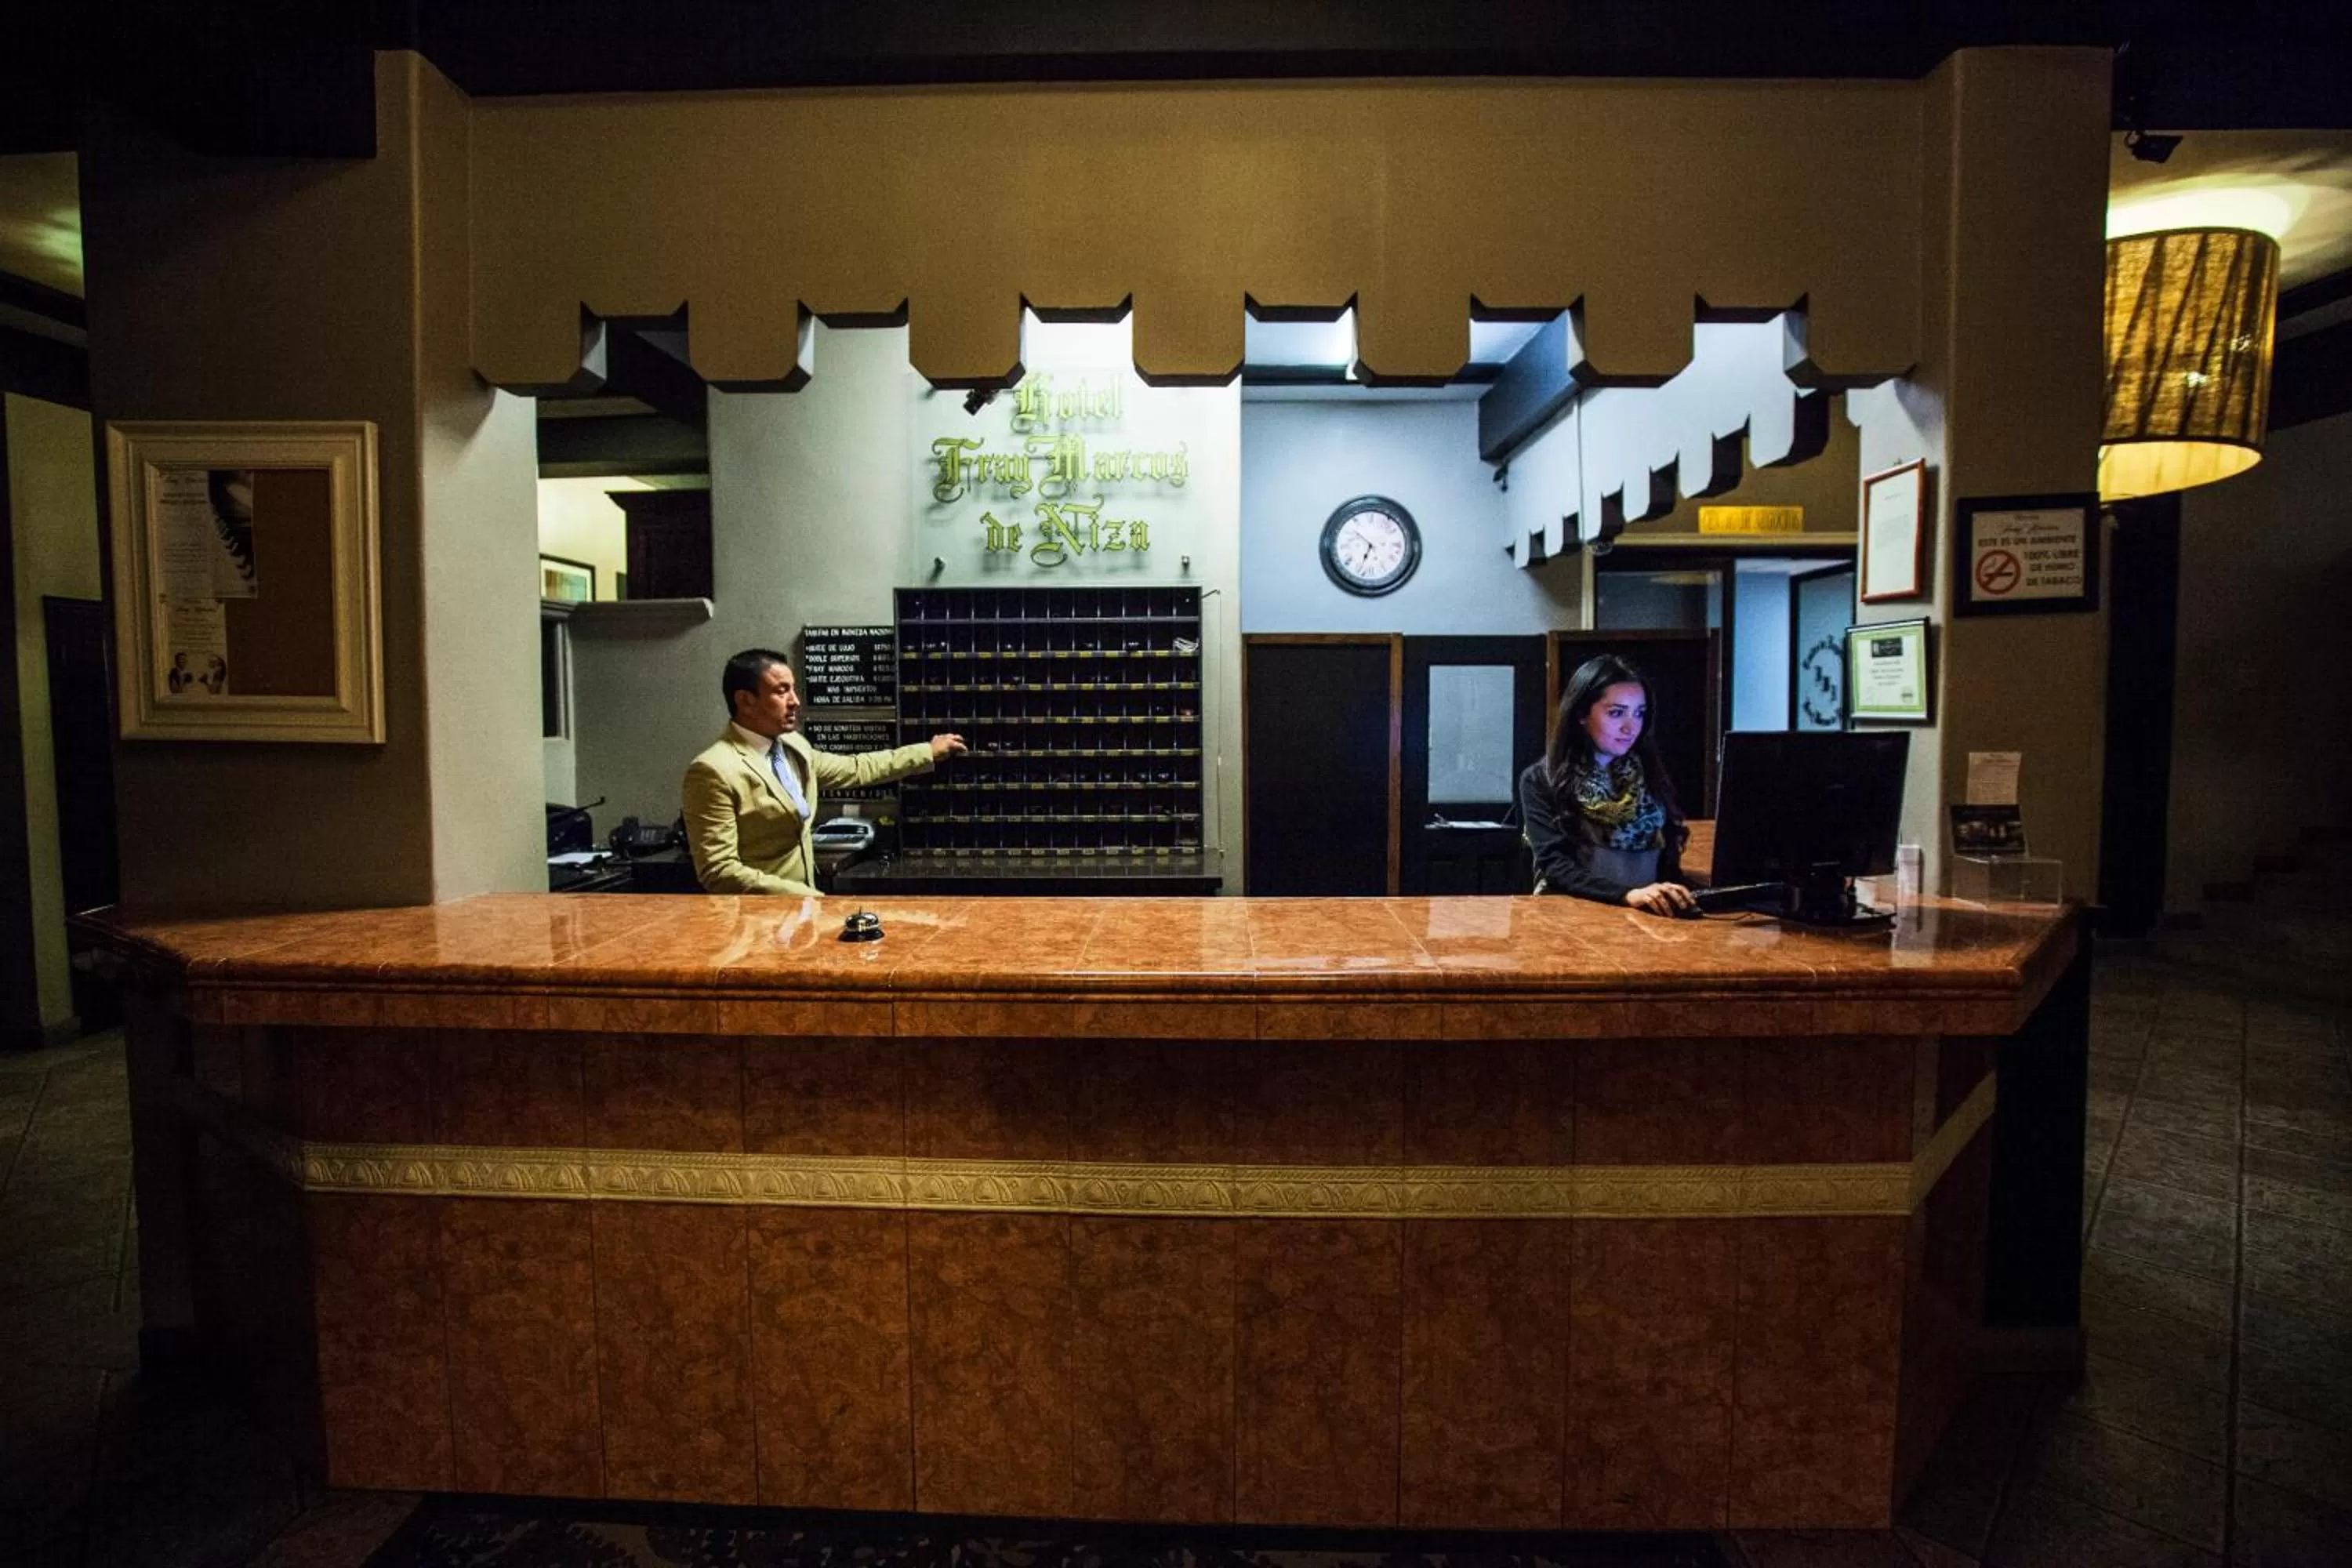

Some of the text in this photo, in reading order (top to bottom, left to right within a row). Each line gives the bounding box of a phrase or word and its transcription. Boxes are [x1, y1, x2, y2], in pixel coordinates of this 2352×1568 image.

[1011, 373, 1123, 433] Hotel
[932, 435, 1189, 503] Fray Marcos
[980, 493, 1151, 568] de Niza
